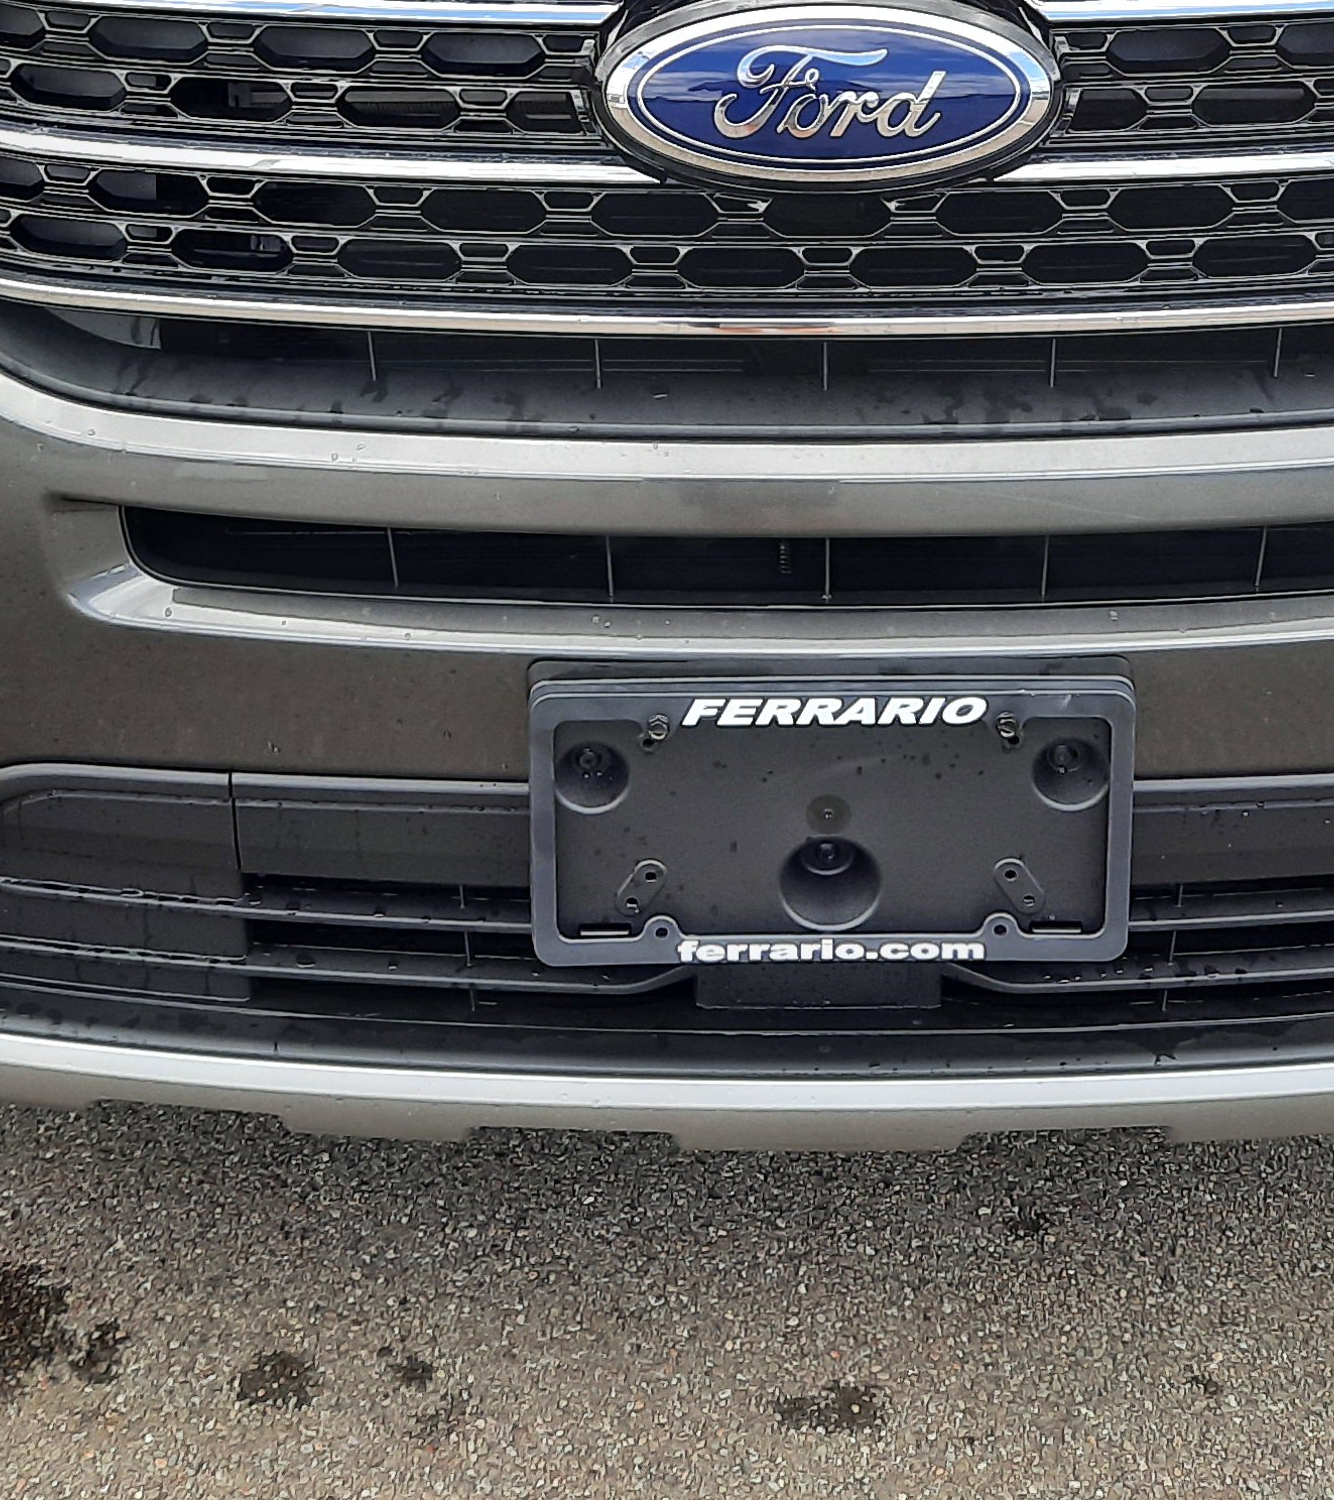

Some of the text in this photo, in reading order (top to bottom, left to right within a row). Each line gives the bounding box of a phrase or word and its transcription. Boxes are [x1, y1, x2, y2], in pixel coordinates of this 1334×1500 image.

[713, 44, 947, 139] Ford
[681, 695, 990, 728] FERRARIO
[677, 937, 986, 963] ferrario.com
